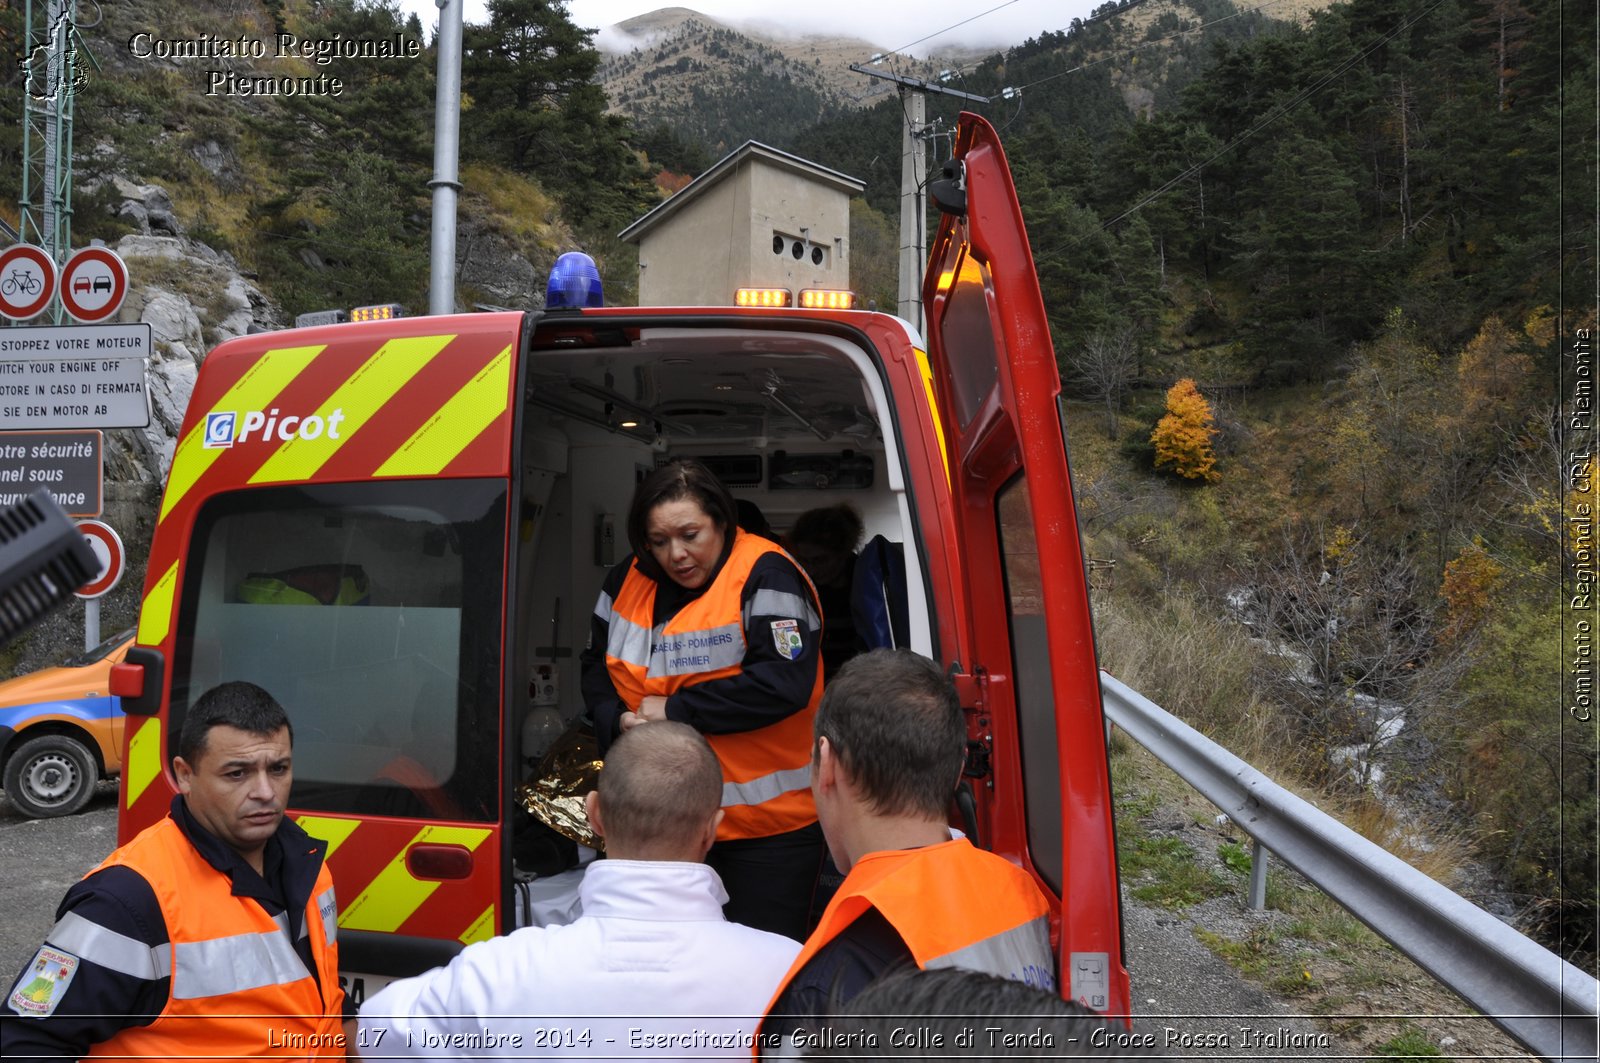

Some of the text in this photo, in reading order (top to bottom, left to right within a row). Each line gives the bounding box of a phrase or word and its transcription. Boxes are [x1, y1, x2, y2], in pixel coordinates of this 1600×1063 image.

[1, 337, 142, 351] STOPPEZ VOTRE MOTEUR
[29, 363, 55, 374] YOUR
[60, 362, 97, 373] ENGINE
[102, 361, 120, 372] OFF
[35, 385, 45, 395] IN
[50, 384, 76, 395] CASO
[81, 384, 91, 395] DI
[96, 383, 142, 394] FERMATA
[3, 404, 108, 417] SIE DEN MOTOR AB
[238, 408, 345, 443] Picot
[31, 441, 93, 459] sécurité
[29, 469, 64, 482] sous
